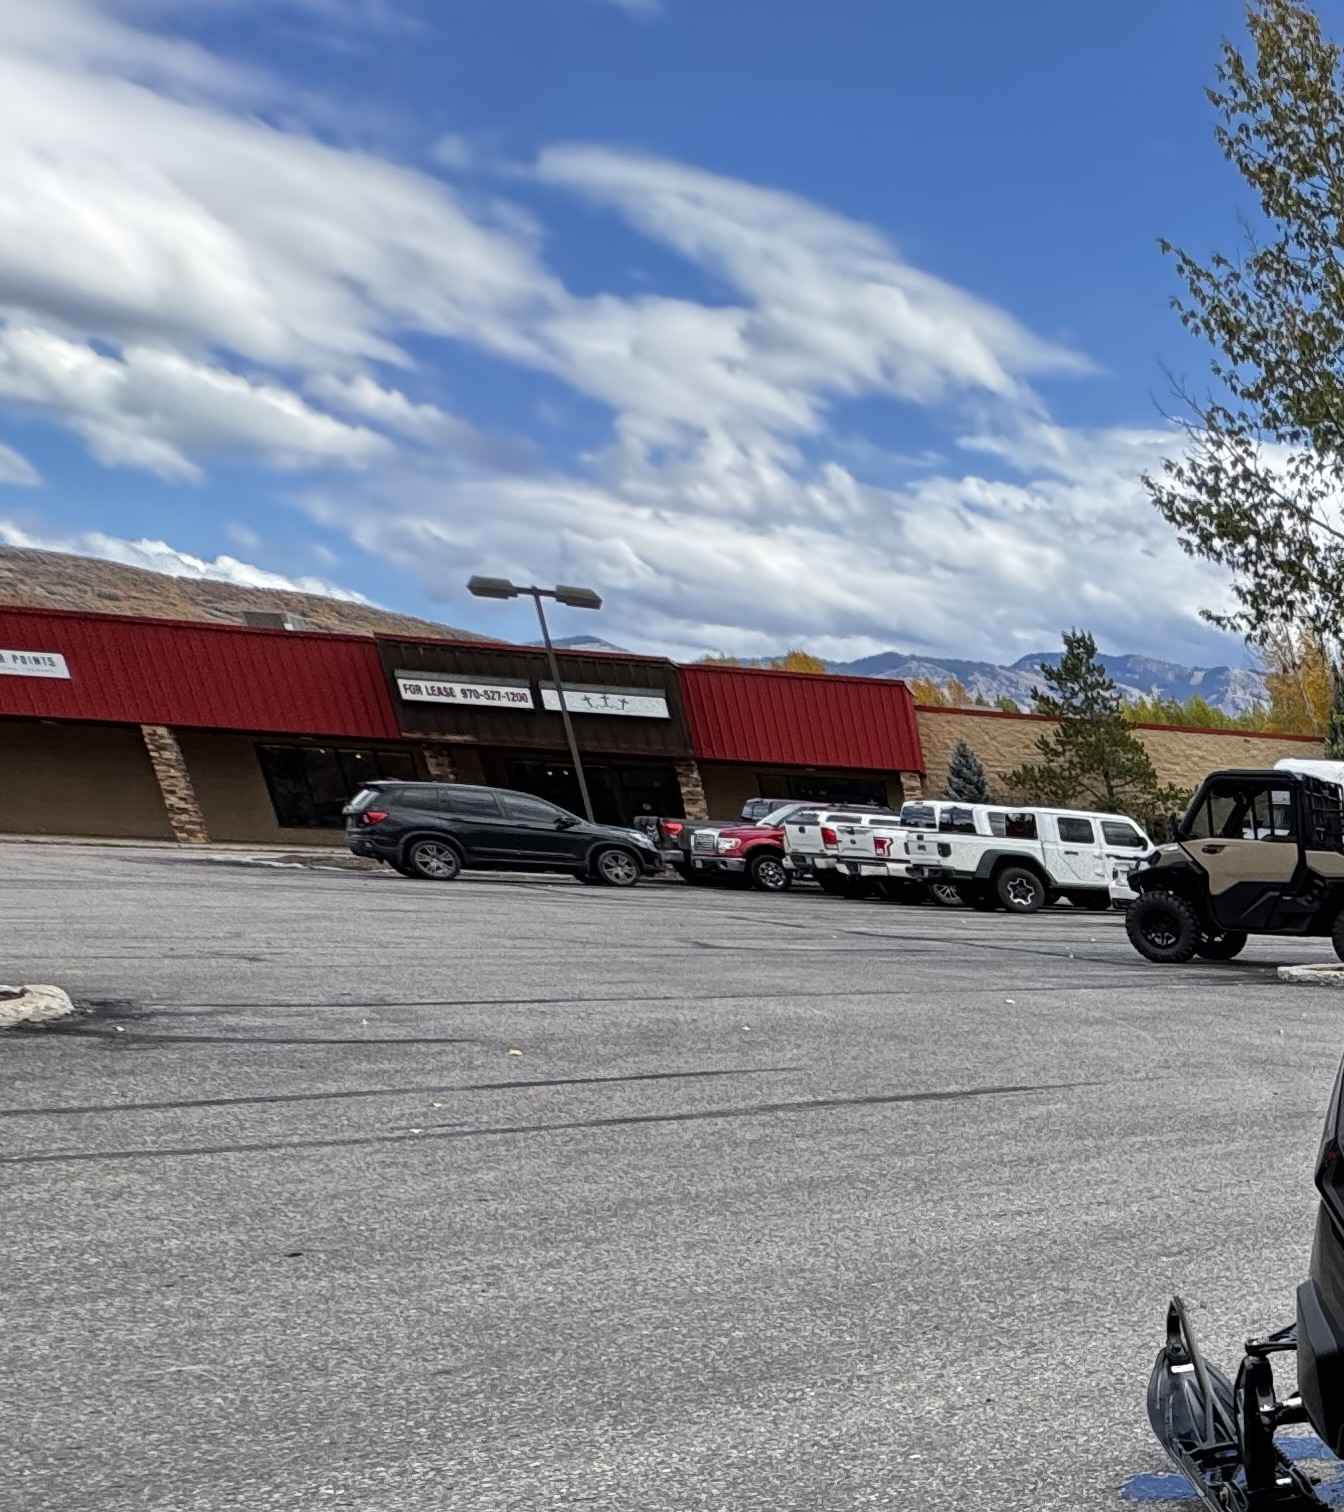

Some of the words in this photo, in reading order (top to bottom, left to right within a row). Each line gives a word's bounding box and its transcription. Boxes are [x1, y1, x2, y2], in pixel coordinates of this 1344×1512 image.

[11, 654, 56, 667] POINTS
[402, 683, 423, 696] FOR
[425, 684, 456, 698] LEASE
